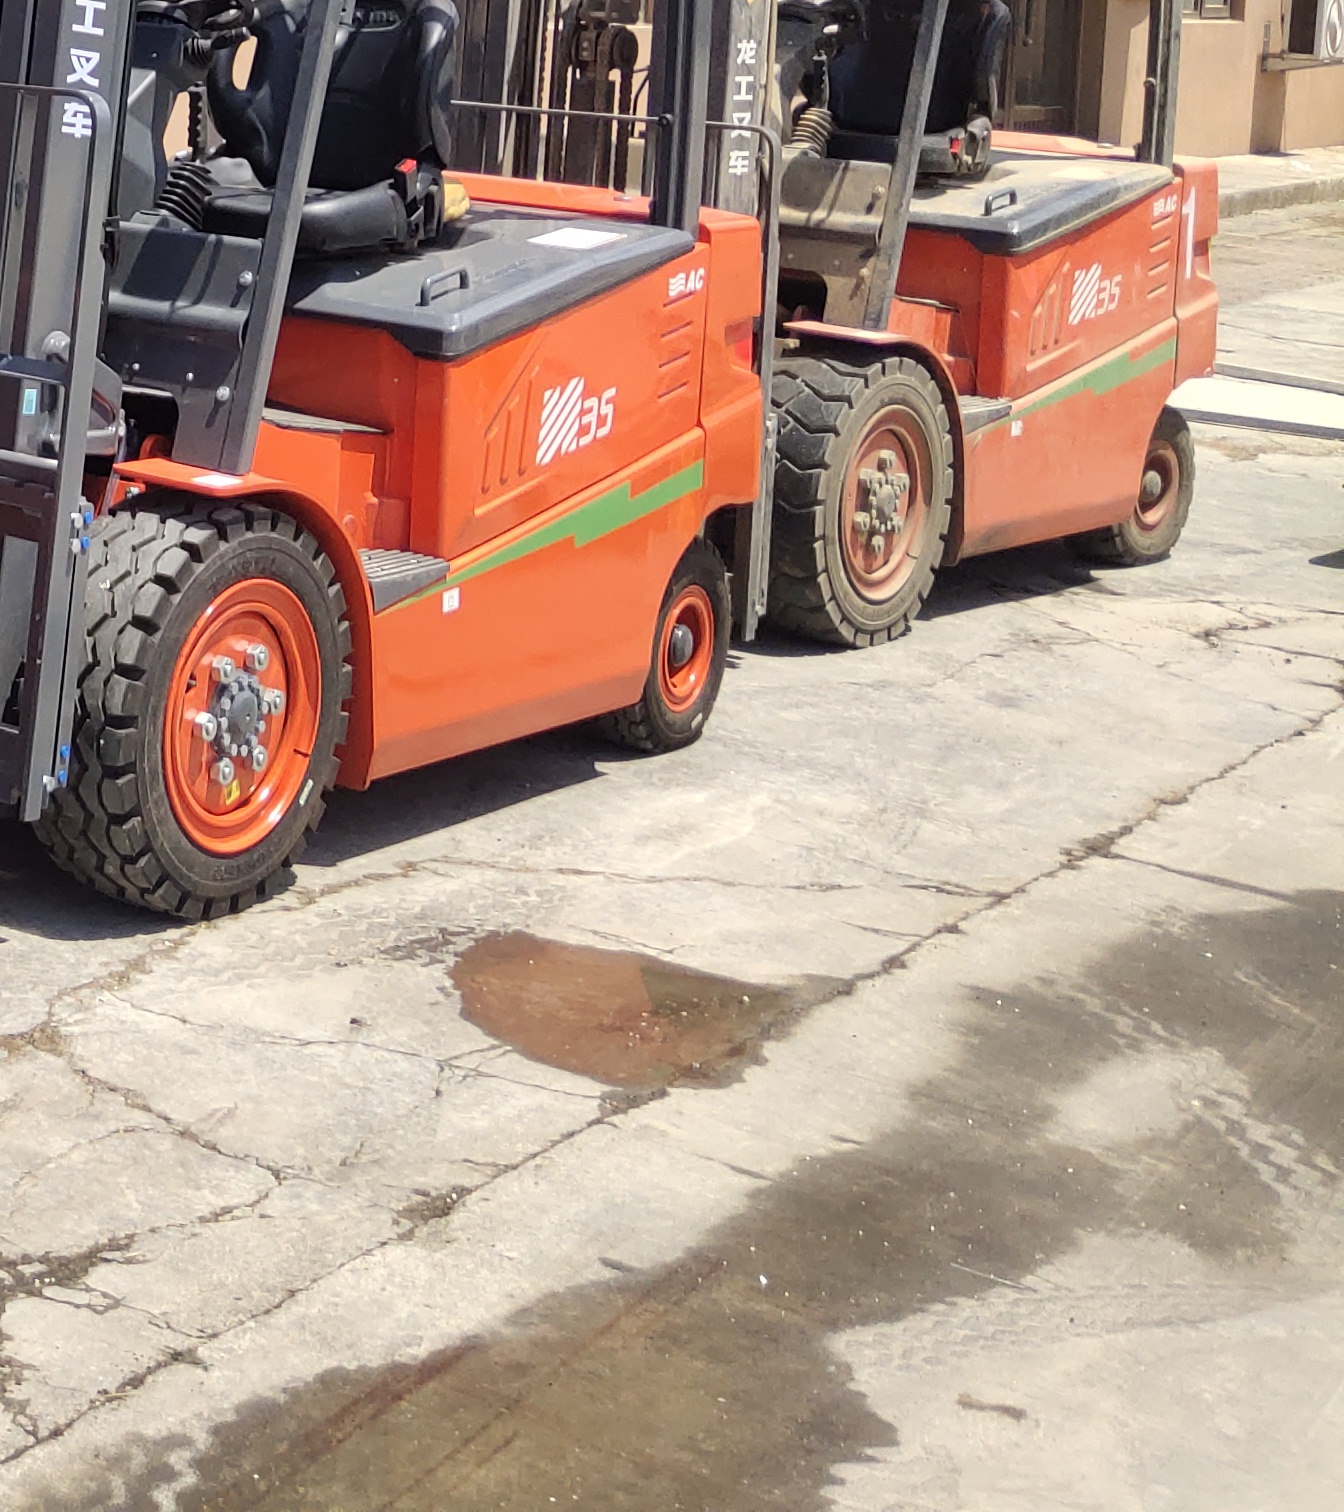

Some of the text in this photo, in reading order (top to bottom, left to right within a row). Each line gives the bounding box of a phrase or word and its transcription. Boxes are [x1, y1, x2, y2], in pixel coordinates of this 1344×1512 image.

[728, 39, 757, 176] 龙工叉车
[1165, 194, 1178, 213] AC
[685, 267, 705, 293] AC
[1096, 273, 1123, 316] 35
[578, 385, 617, 447] 35
